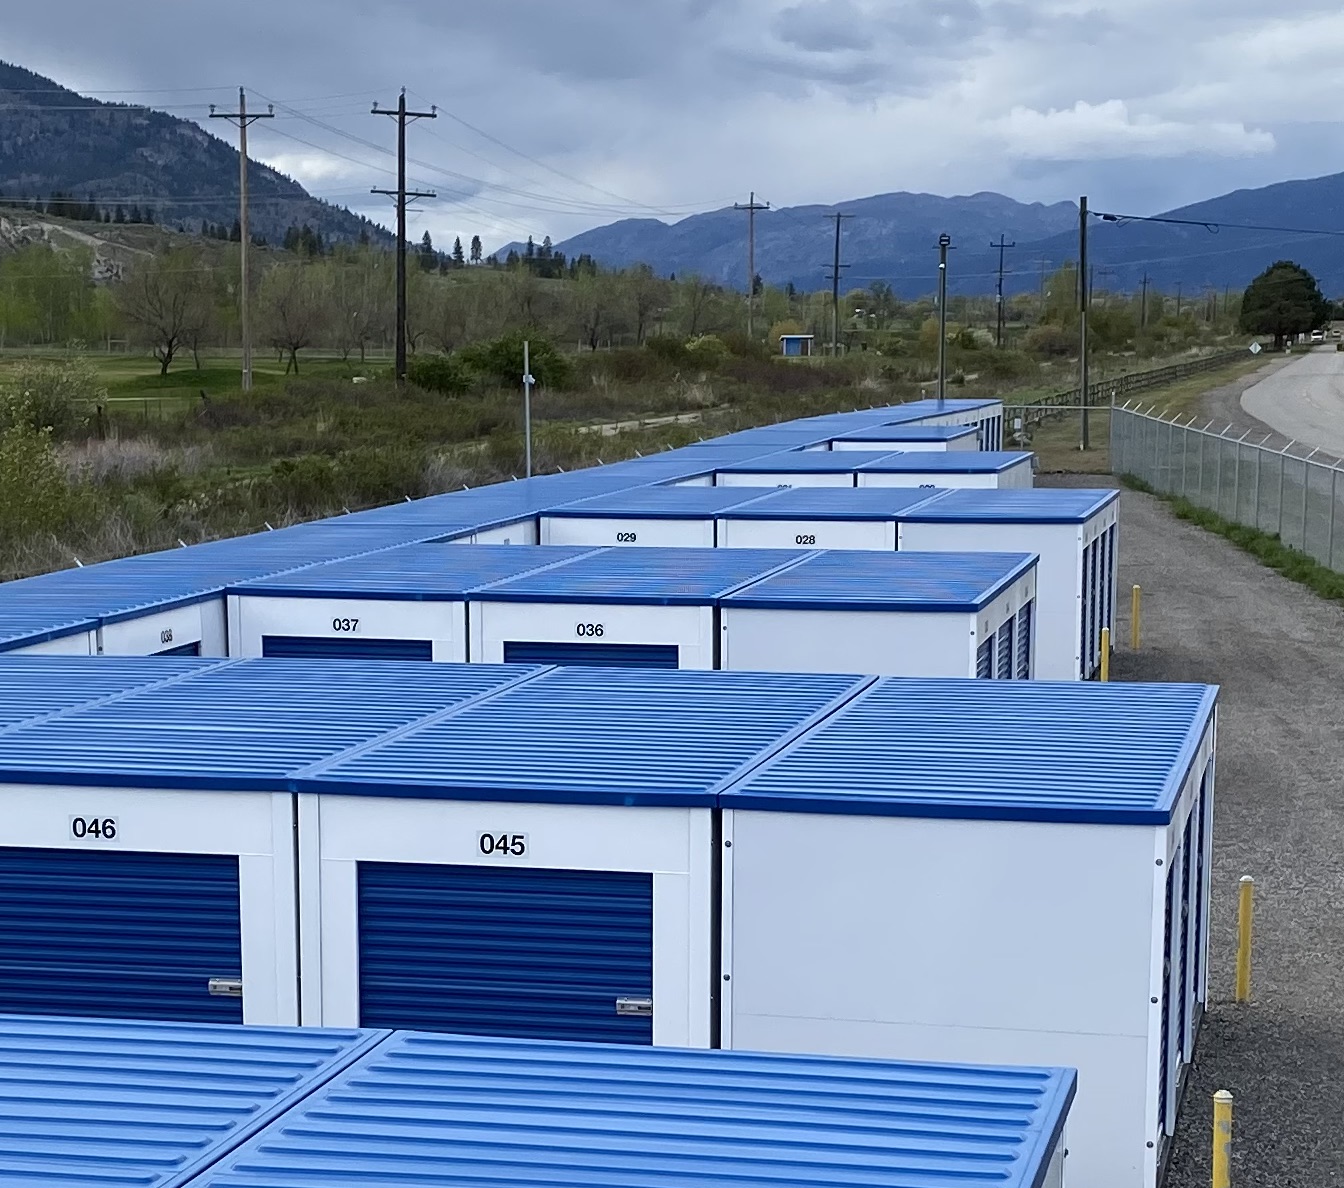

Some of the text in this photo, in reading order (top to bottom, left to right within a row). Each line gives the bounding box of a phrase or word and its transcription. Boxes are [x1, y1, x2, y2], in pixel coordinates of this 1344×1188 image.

[617, 533, 636, 543] 029
[795, 535, 816, 545] 028
[332, 618, 359, 633] 037
[576, 623, 604, 637] 036
[72, 817, 117, 839] 046
[479, 833, 526, 856] 045
